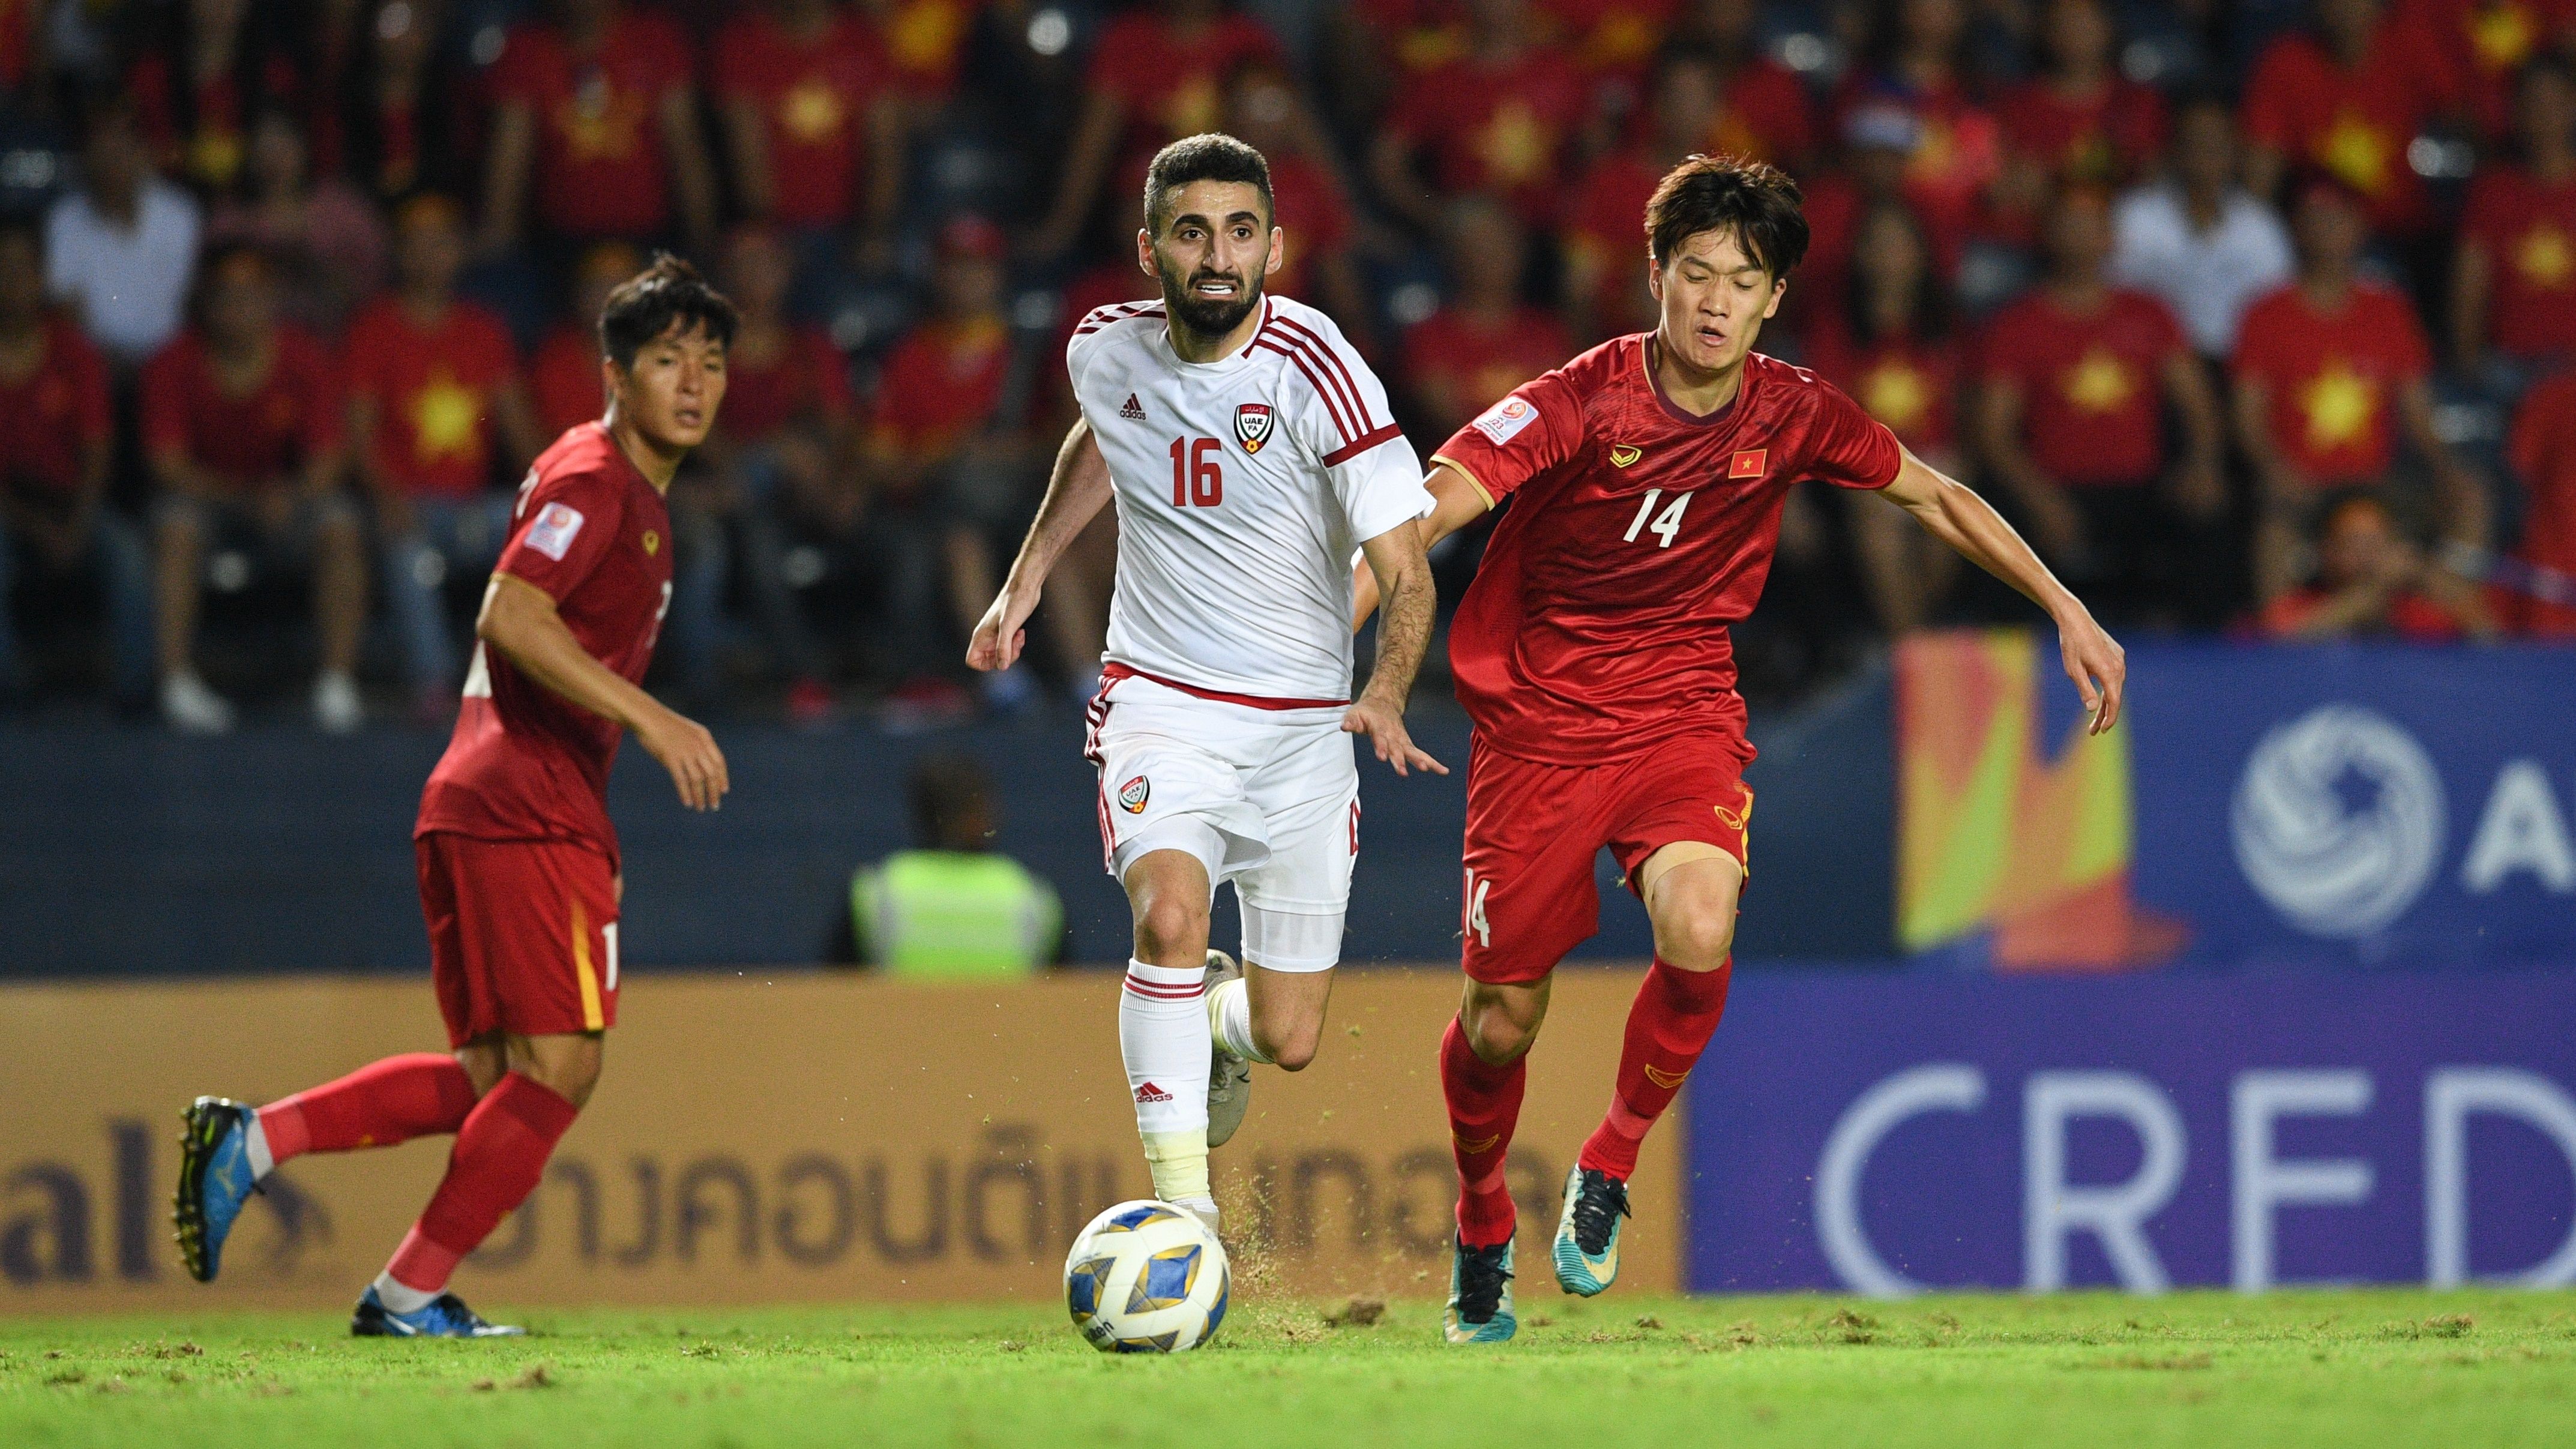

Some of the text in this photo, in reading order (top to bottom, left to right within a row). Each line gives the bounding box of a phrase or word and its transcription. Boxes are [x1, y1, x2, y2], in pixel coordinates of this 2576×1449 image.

[1120, 409, 1146, 420] adidas
[1170, 435, 1223, 507] 16
[1623, 488, 1694, 548] 14
[1126, 786, 1140, 797] UAE
[1466, 867, 1491, 948] 14
[1136, 1093, 1173, 1103] didas
